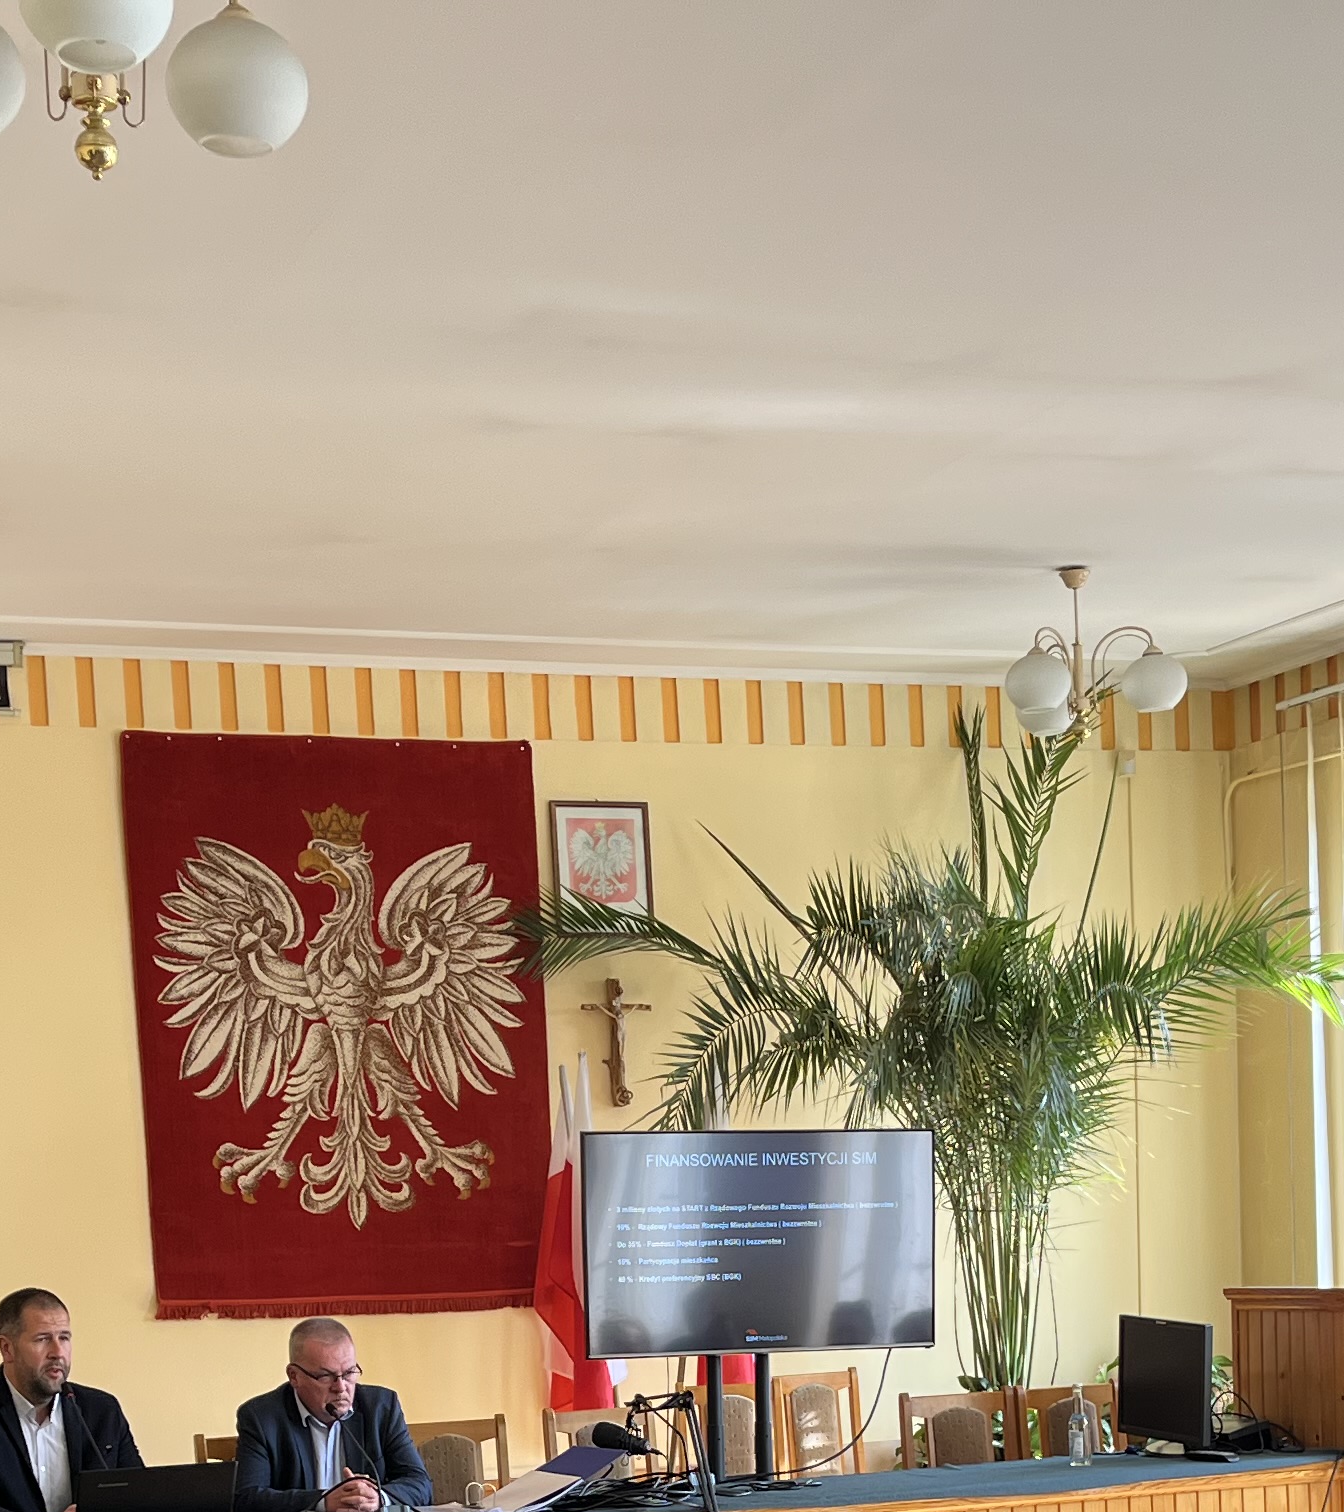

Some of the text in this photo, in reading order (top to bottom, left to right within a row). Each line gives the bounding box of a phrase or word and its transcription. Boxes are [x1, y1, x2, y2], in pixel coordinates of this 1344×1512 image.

[646, 1152, 877, 1167] FINANSOWANIE INWESTYCJI SIM
